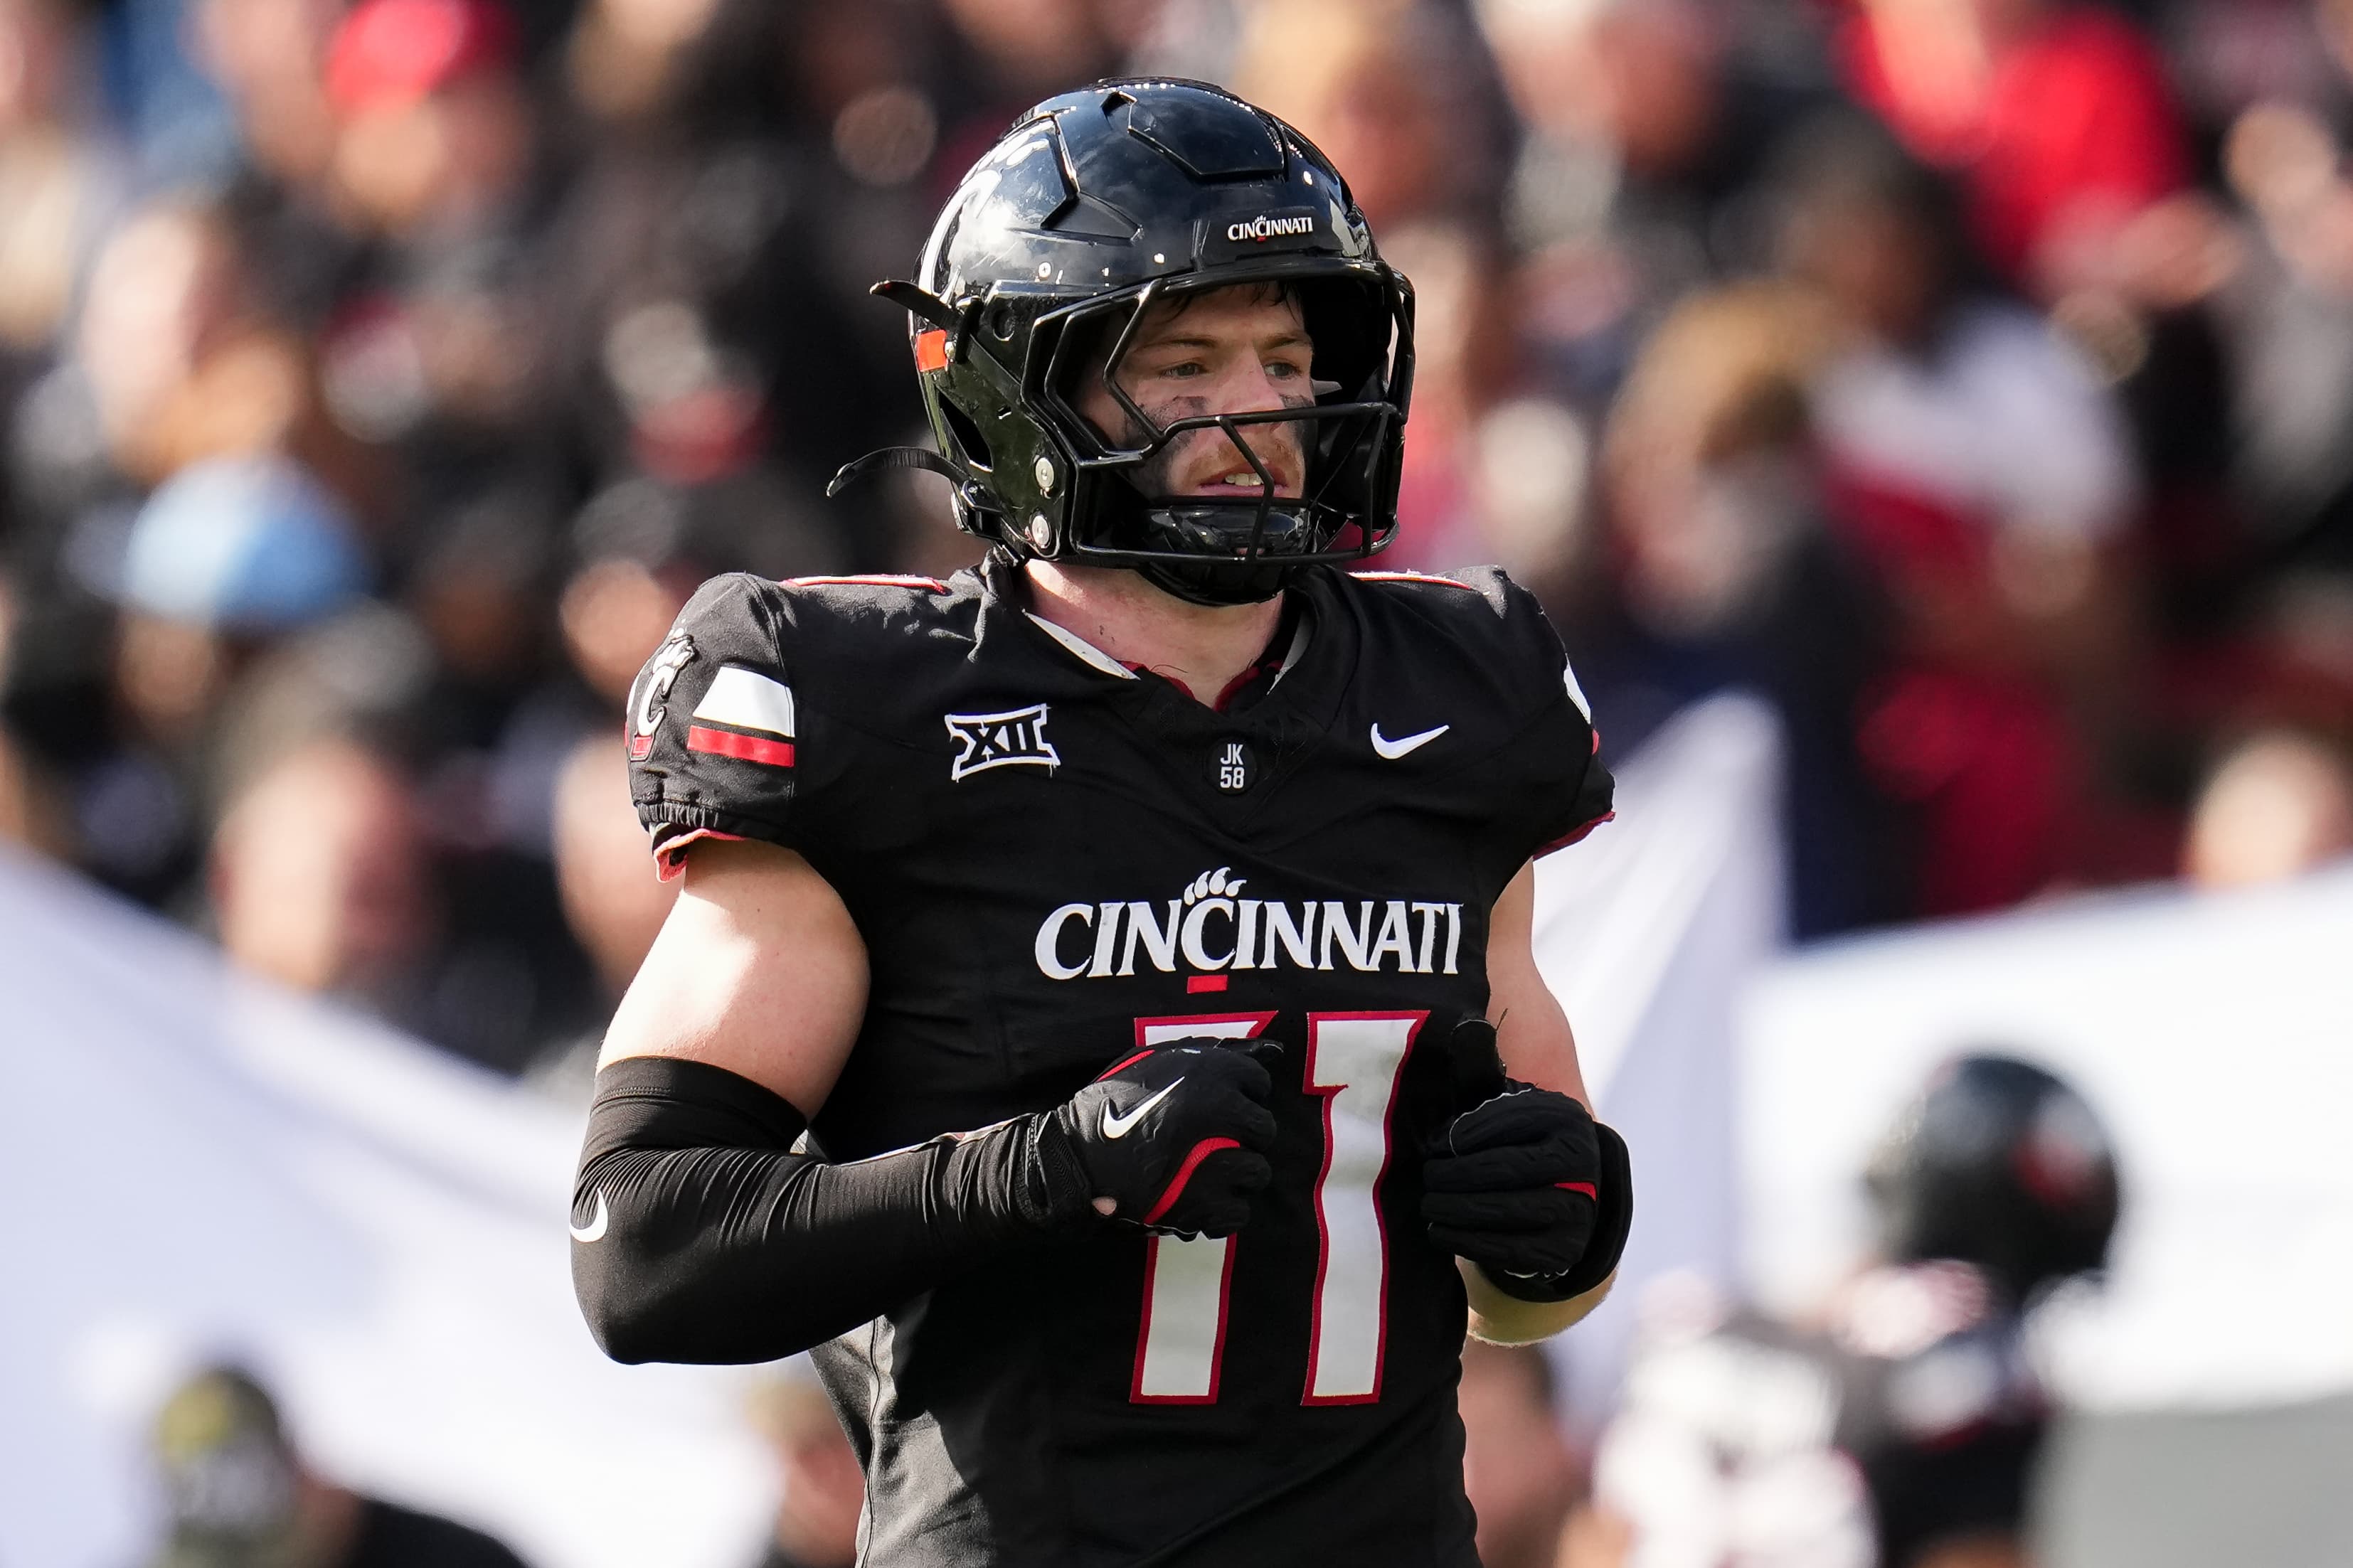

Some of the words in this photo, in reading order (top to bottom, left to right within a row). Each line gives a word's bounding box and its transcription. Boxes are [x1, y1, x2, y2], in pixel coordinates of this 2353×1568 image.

[1228, 217, 1313, 240] CINCINNATI
[1220, 743, 1243, 765] JK
[1220, 767, 1245, 789] 58
[1035, 896, 1463, 980] CINCINNATI
